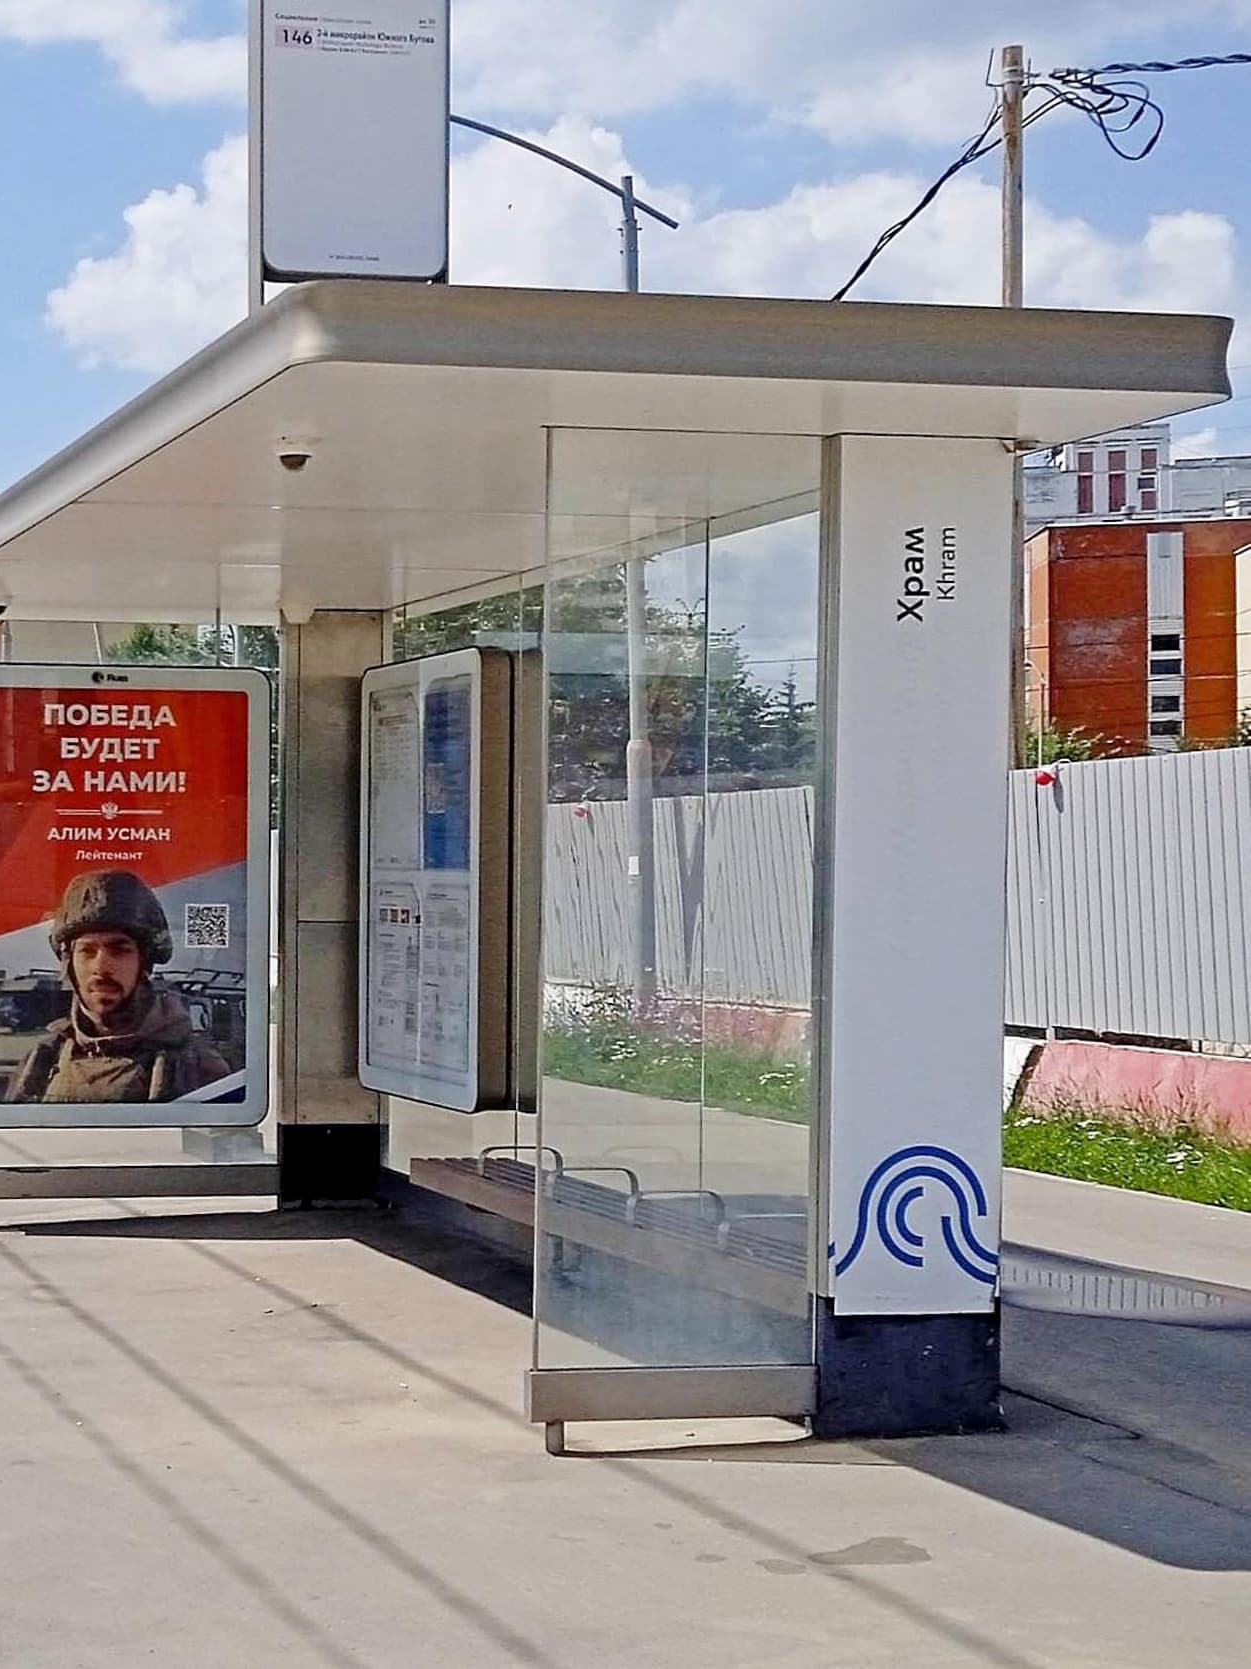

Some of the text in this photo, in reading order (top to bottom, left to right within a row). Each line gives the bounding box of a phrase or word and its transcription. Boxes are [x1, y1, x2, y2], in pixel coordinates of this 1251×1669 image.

[282, 29, 313, 45] 146
[329, 31, 376, 42] микрорайон
[377, 31, 407, 44] Южного
[896, 527, 930, 622] Храм
[935, 527, 956, 600] Khram
[44, 703, 178, 730] ПОБЕДА
[60, 737, 161, 763] БУДЕТ
[32, 770, 186, 793] ЗА НАМИ!
[47, 827, 171, 841] АЛИМ УСМАН
[75, 849, 143, 861] Лейтенант
